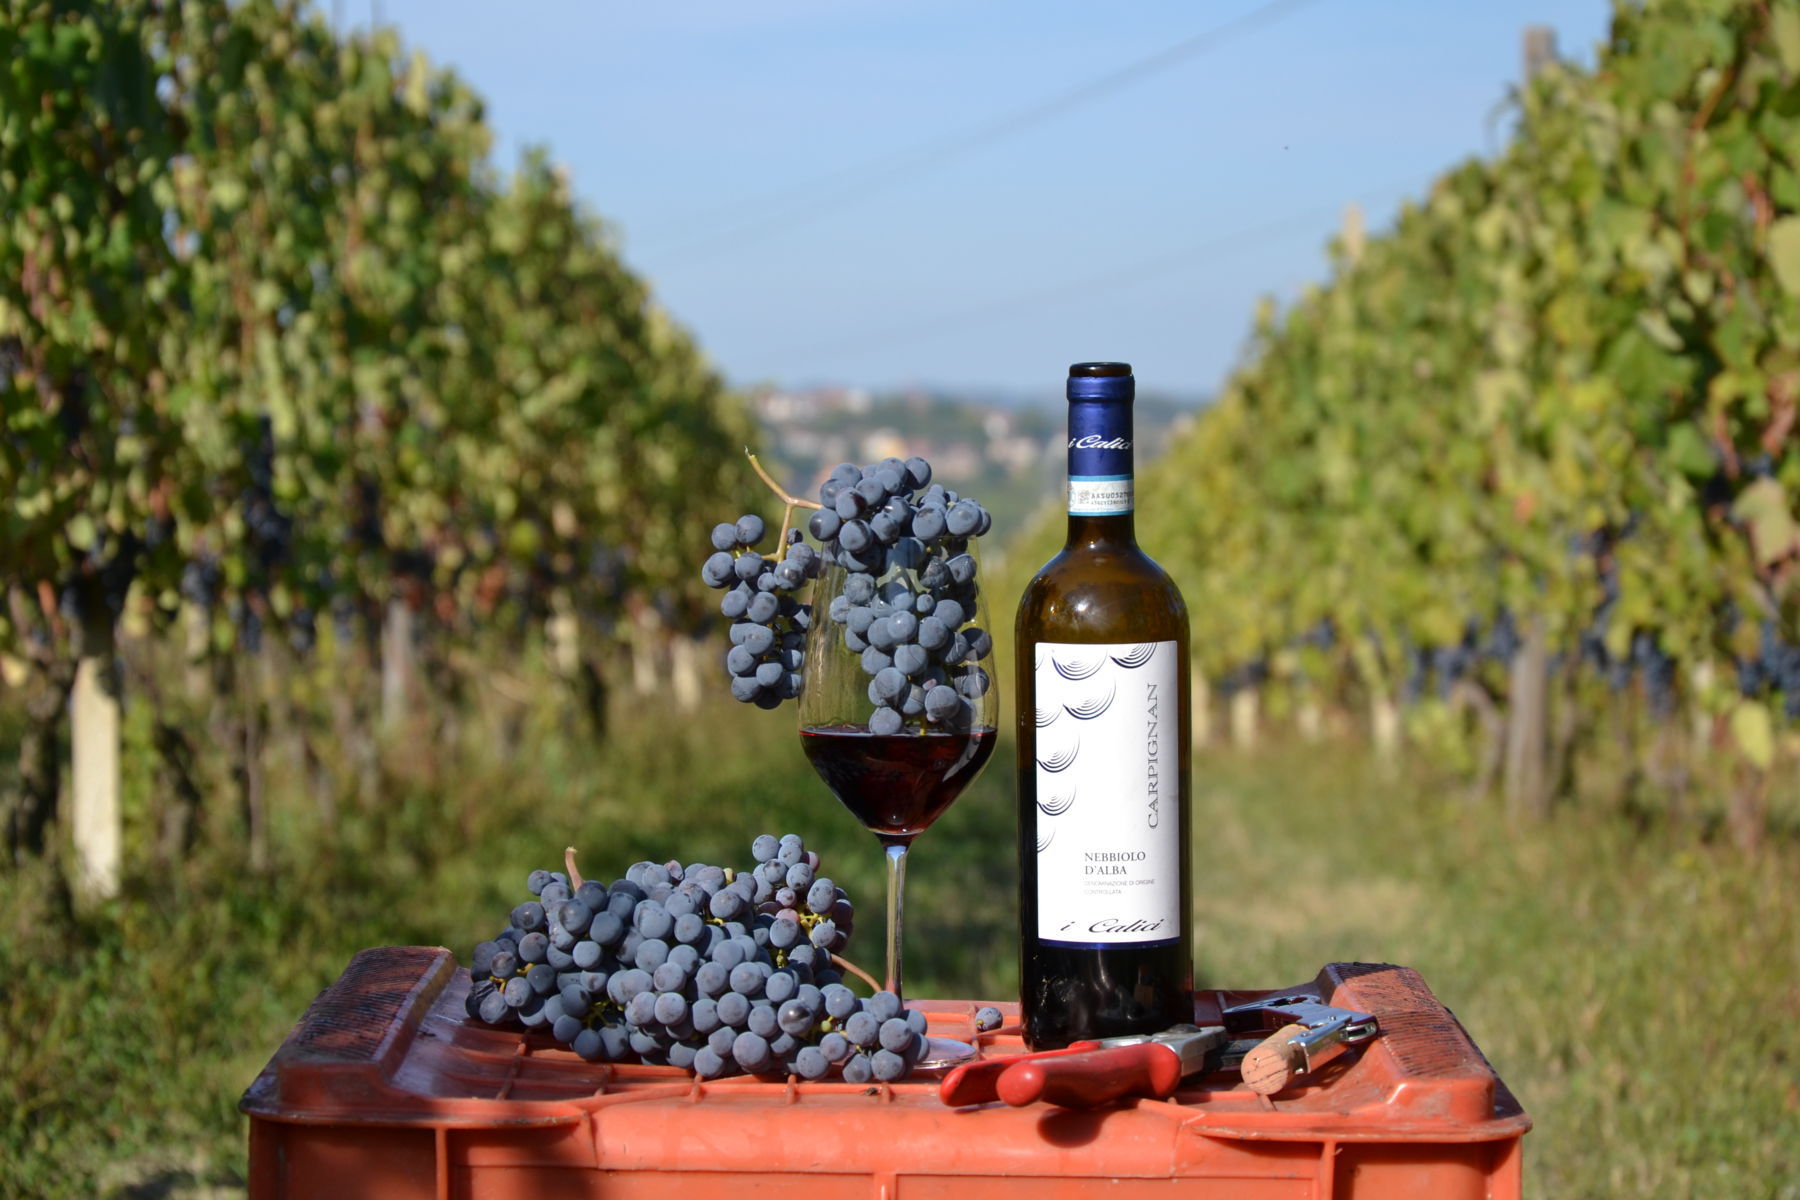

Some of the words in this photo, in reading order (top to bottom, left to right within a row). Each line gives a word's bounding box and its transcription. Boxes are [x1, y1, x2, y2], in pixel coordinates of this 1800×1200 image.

[1147, 682, 1159, 829] CARPIGNAN
[1084, 851, 1146, 862] NEBBIOLO
[1084, 865, 1127, 875] D'ALBA
[1060, 921, 1075, 931] i
[1088, 918, 1164, 933] Calici
